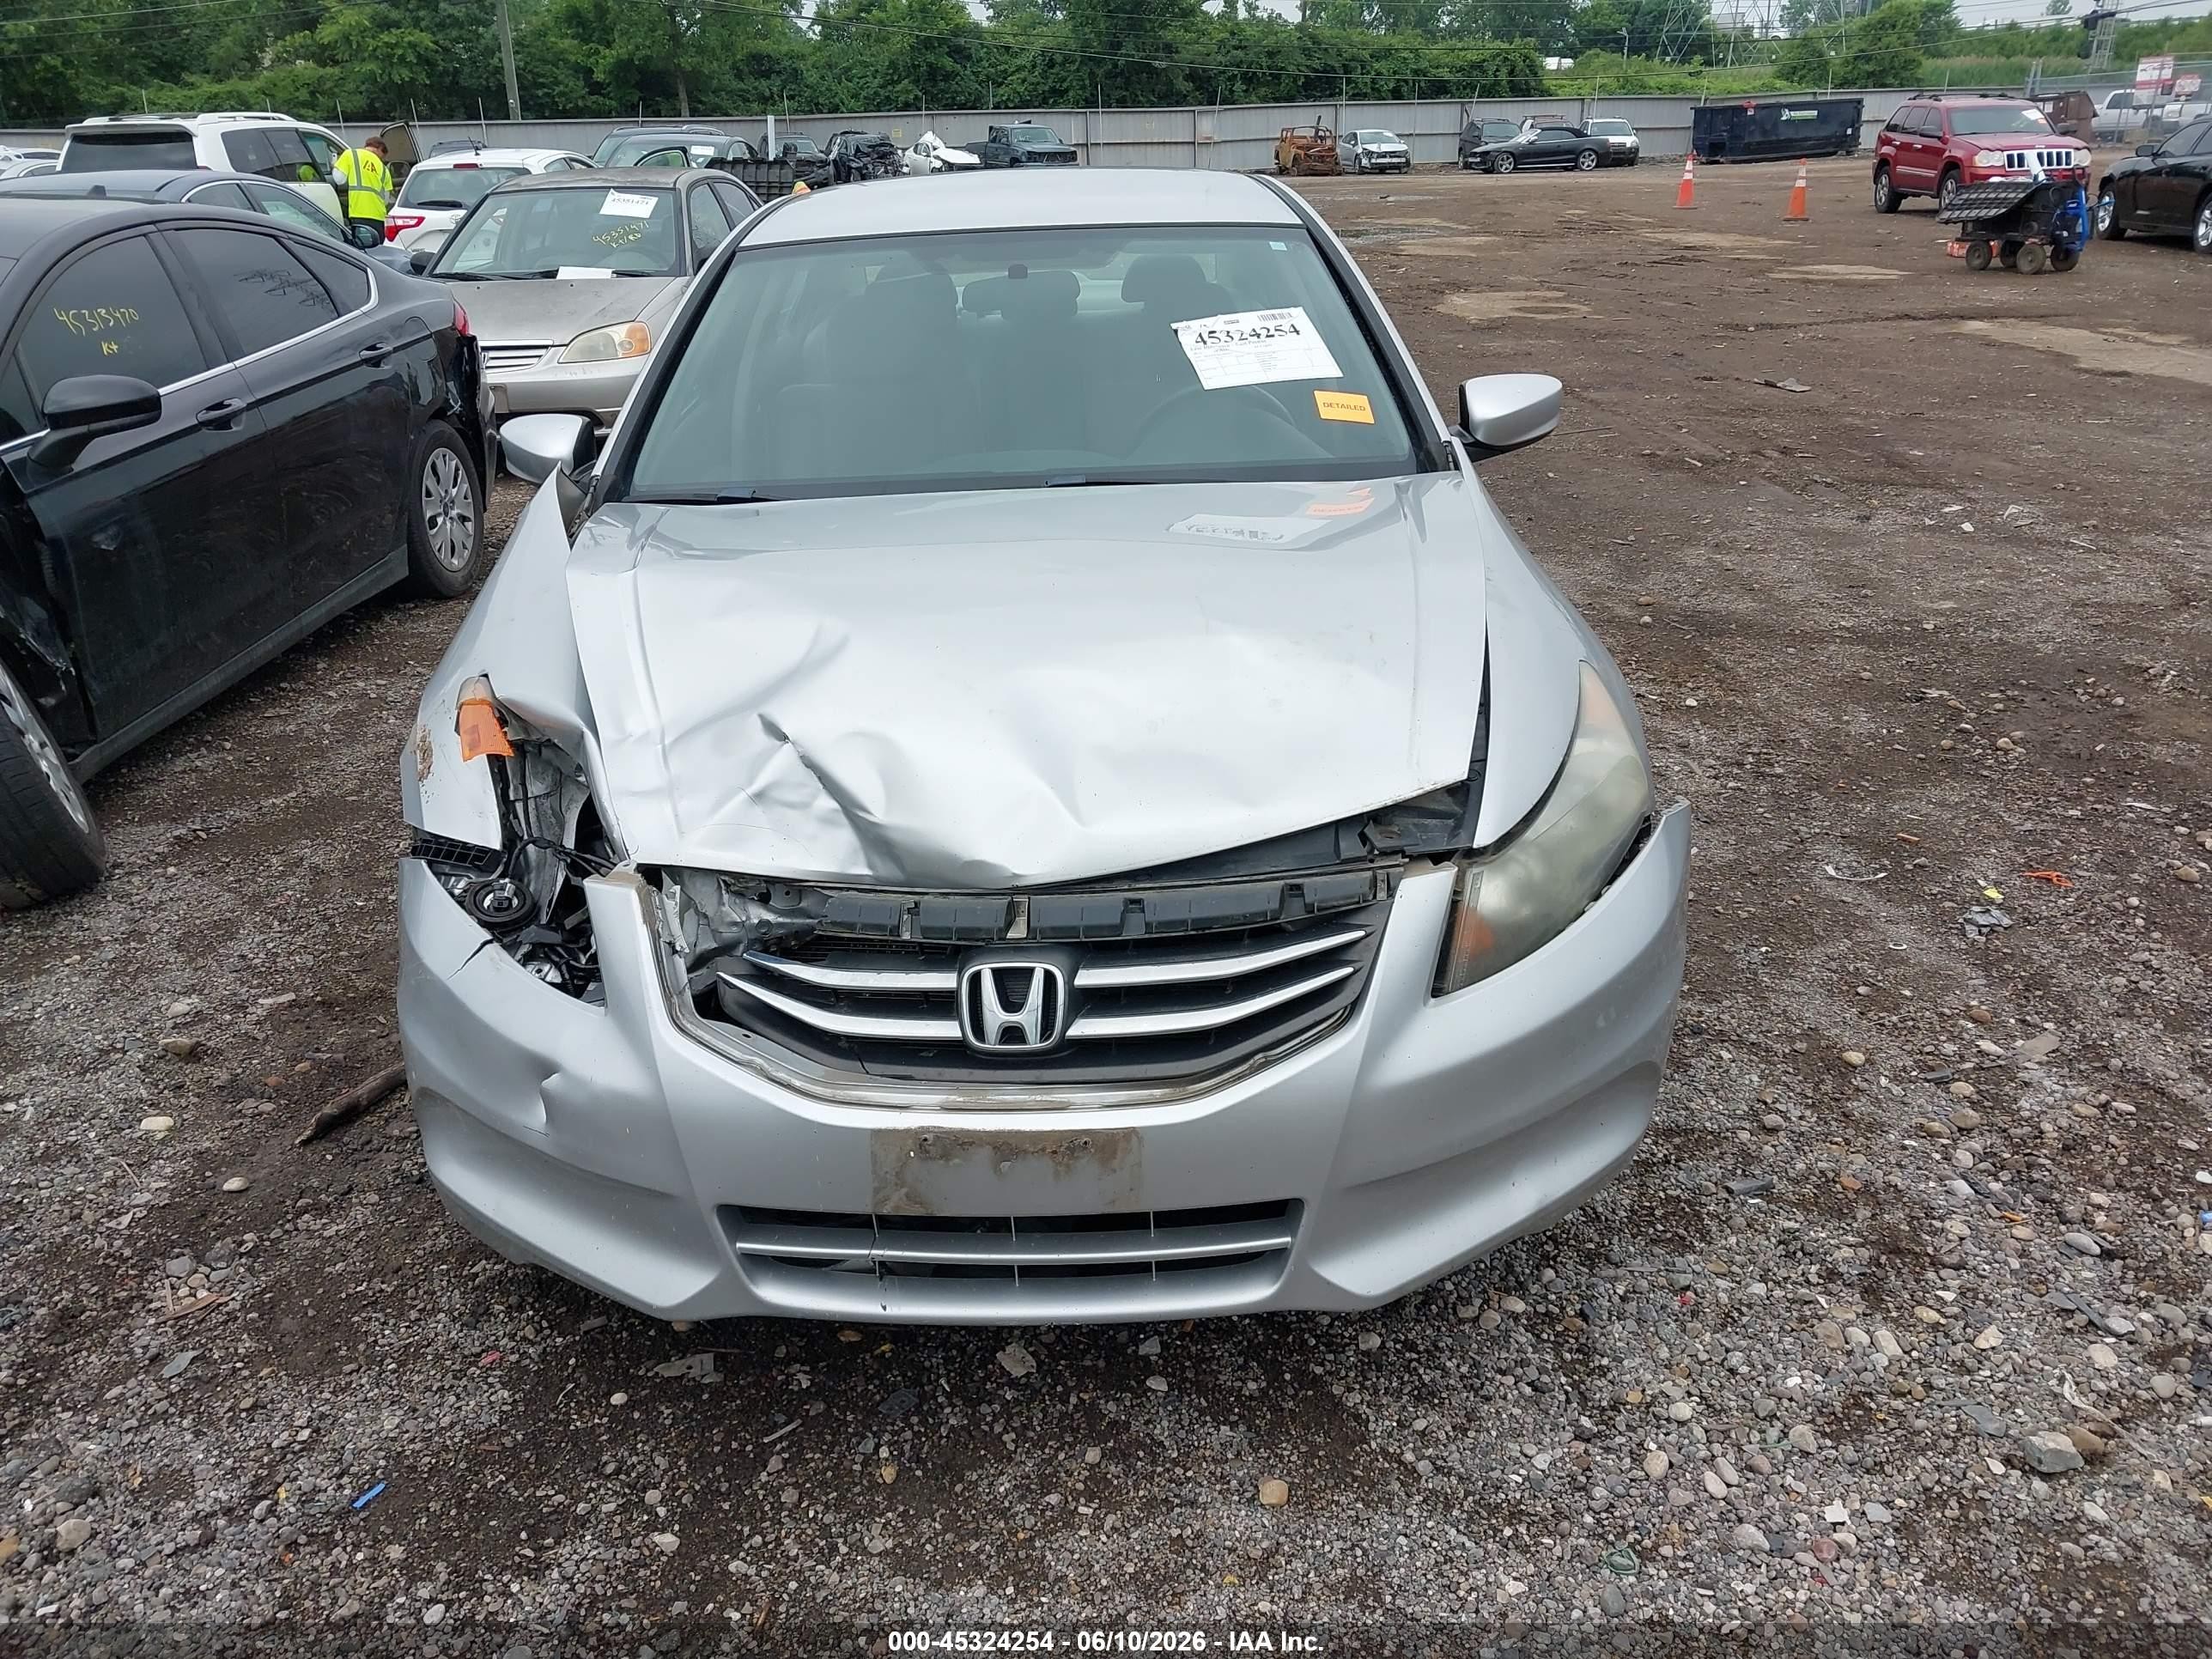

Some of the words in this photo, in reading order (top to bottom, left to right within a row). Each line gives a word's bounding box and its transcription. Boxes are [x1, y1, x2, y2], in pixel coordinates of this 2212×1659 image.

[592, 220, 649, 246] 45351471
[53, 307, 139, 337] 45313470
[1194, 324, 1301, 345] 45324254
[1322, 401, 1366, 411] DETAILED
